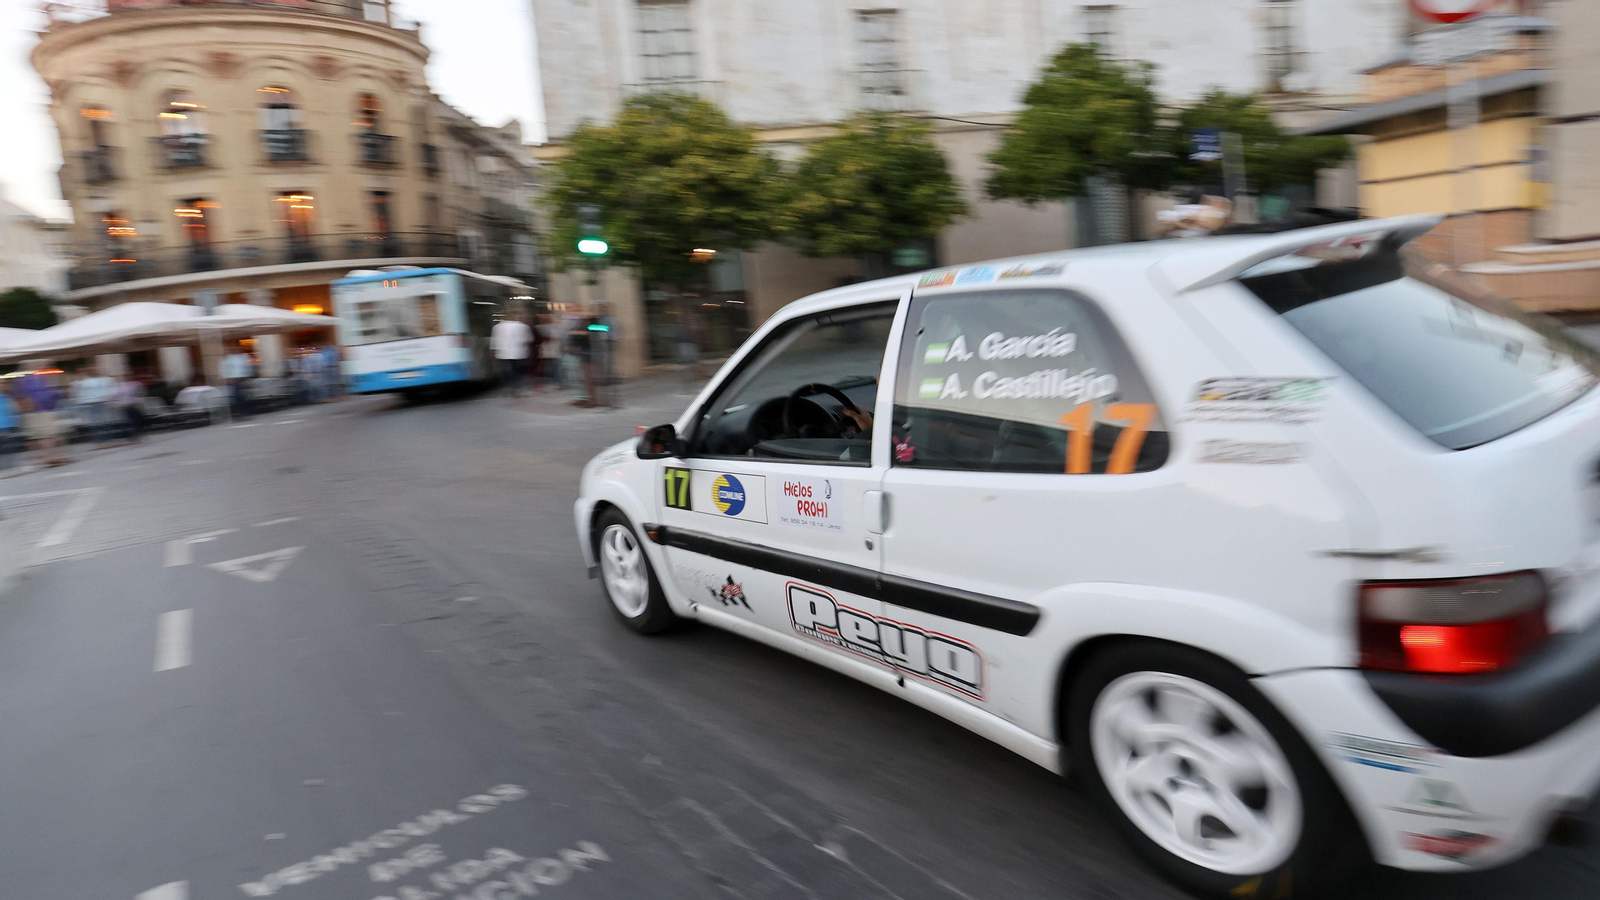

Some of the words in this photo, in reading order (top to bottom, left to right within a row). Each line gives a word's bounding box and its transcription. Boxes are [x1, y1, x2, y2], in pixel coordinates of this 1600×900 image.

[945, 335, 974, 362] A.
[978, 327, 1077, 361] García
[939, 373, 968, 400] A.
[972, 368, 1119, 405] Castillejo
[1059, 402, 1158, 474] 17
[664, 469, 690, 507] 17
[789, 586, 982, 694] Peyo
